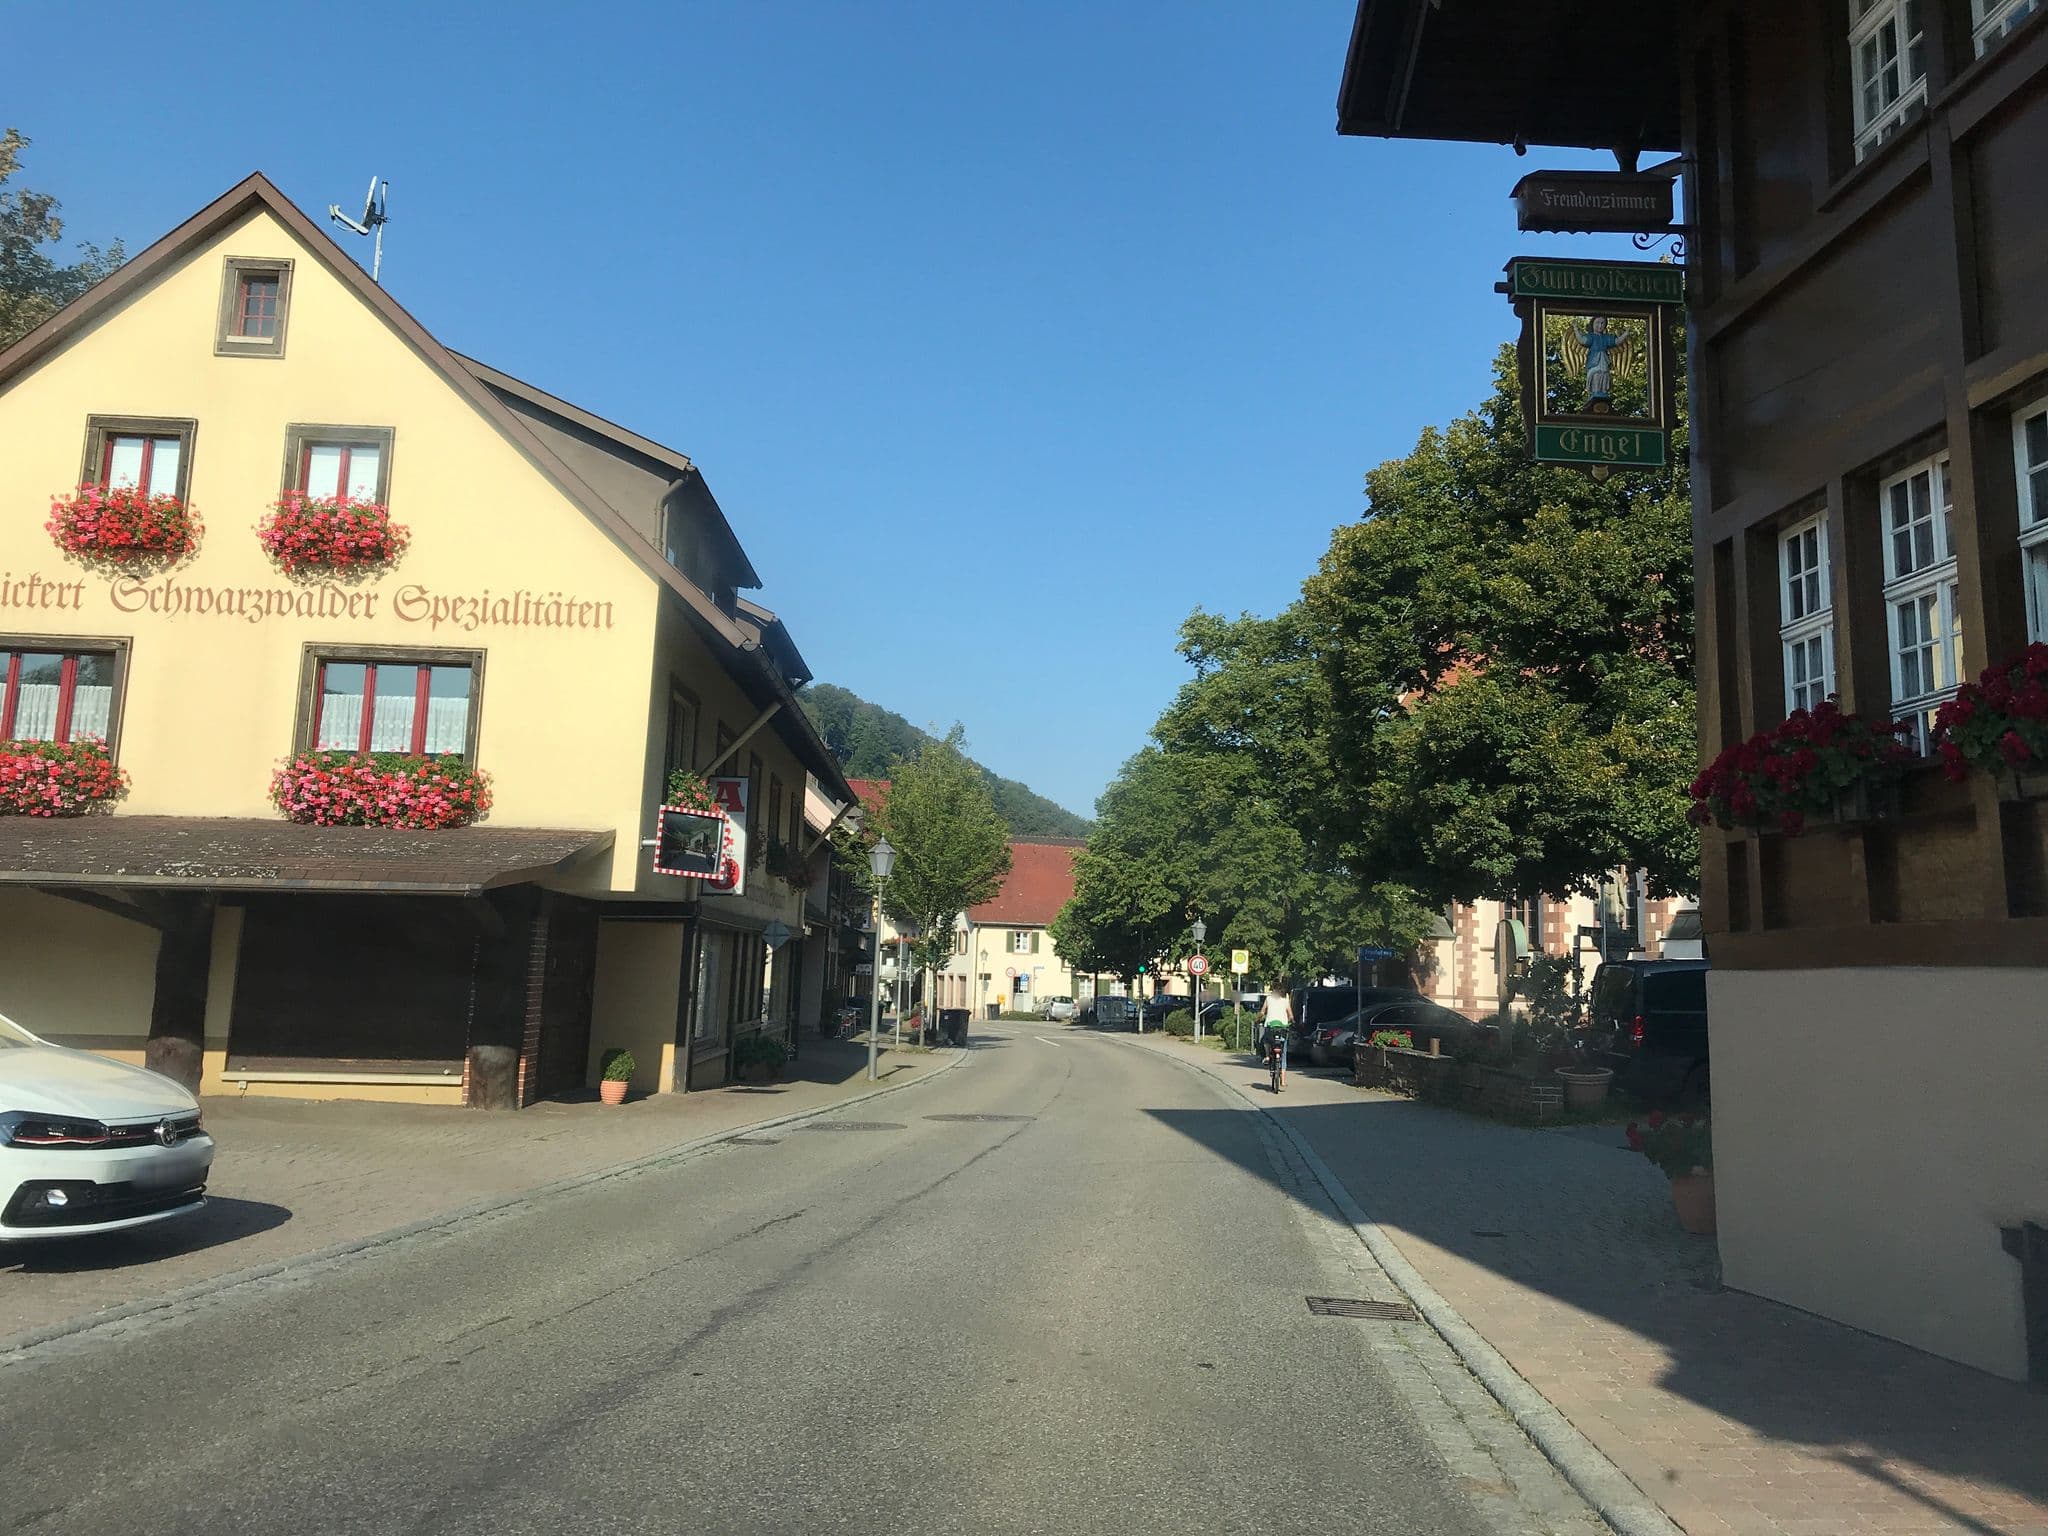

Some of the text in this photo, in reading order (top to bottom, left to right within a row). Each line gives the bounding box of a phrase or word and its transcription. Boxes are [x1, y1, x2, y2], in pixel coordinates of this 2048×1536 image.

[1540, 188, 1657, 209] Fremdenzimmer
[1559, 429, 1640, 461] Engel
[393, 584, 615, 632] Spezialitäten
[1193, 961, 1203, 969] 40
